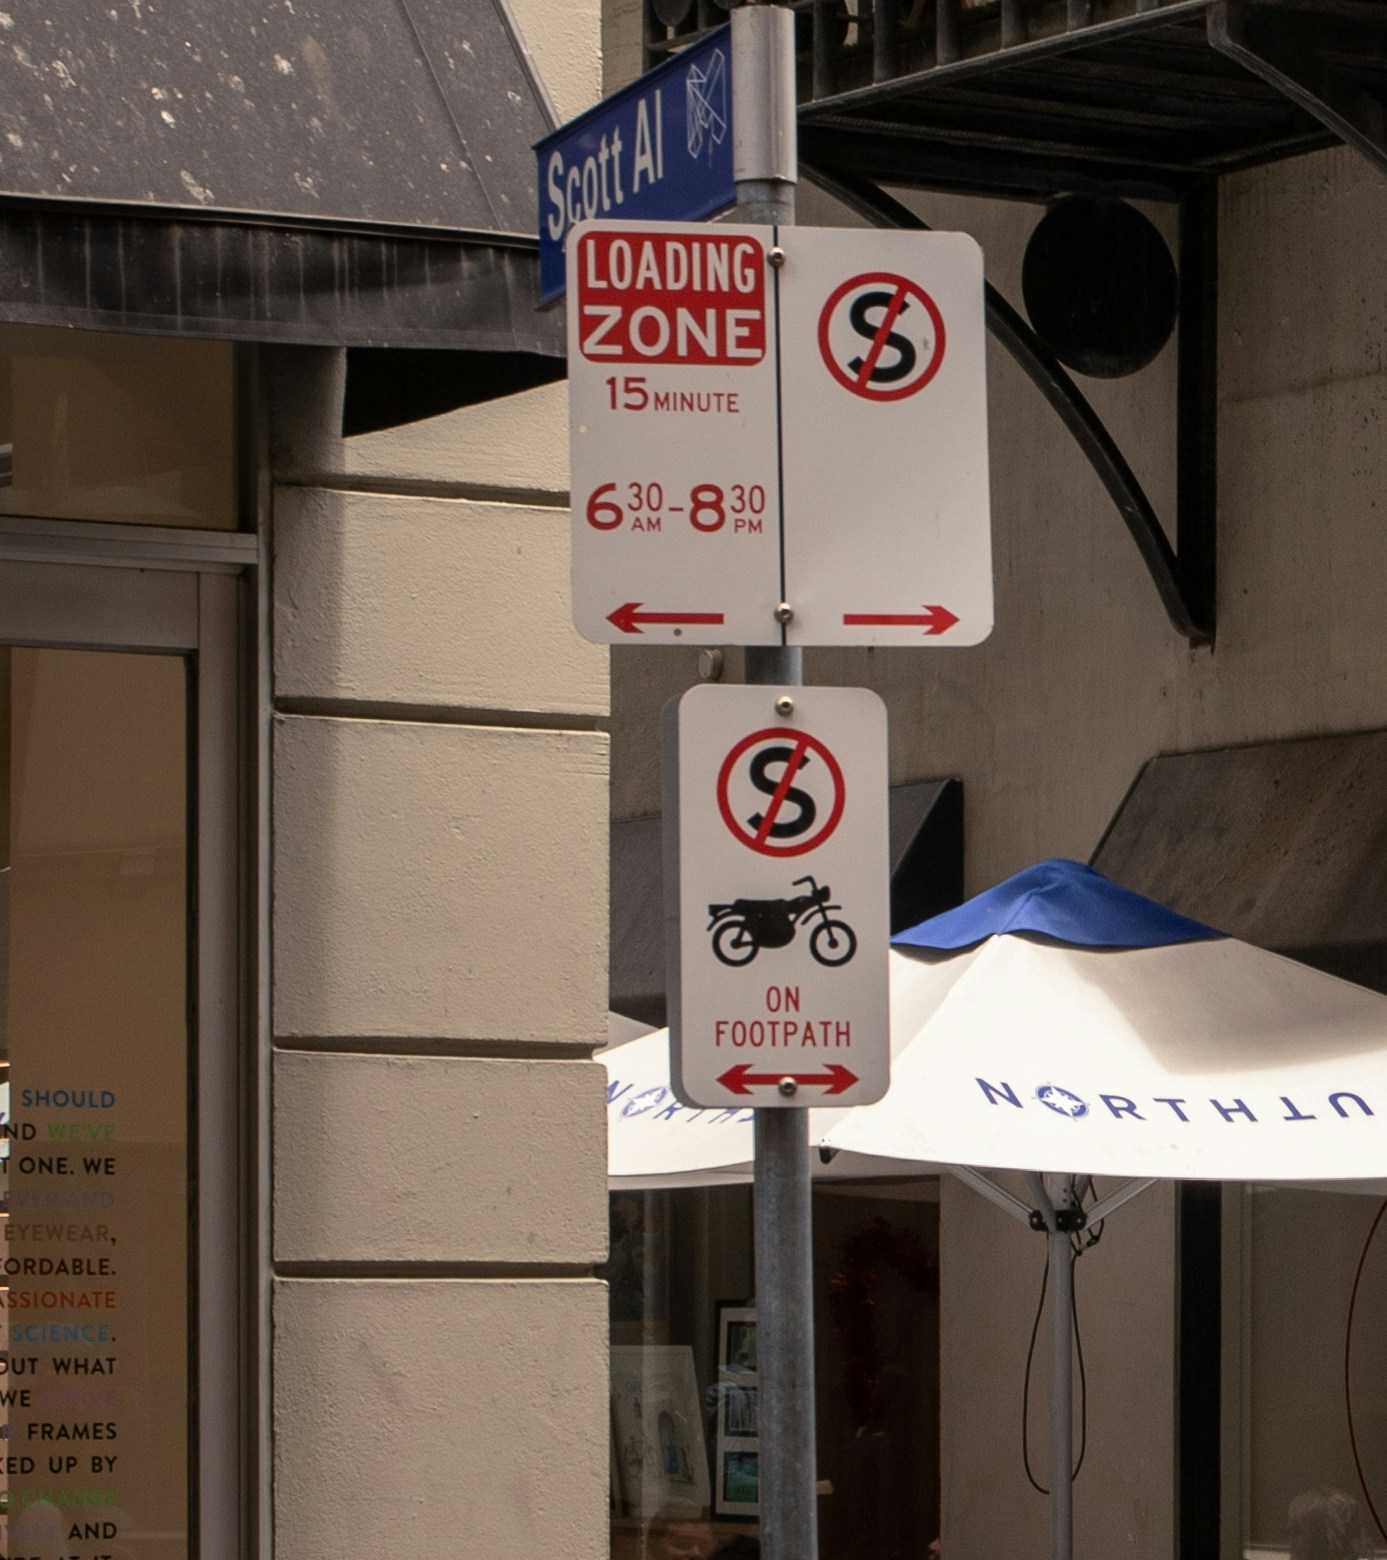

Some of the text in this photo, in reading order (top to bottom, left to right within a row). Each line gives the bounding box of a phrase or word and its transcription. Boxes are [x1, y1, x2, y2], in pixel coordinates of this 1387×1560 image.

[548, 88, 664, 241] Scott Al
[586, 239, 755, 293] LOADING
[583, 305, 762, 358] ZONE
[606, 377, 739, 412] 15 MINUTE
[765, 987, 801, 1013] ON
[715, 1020, 852, 1049] FOOTPATH
[21, 1088, 116, 1109] SHOULD
[19, 1156, 116, 1175] ONE. WE
[0, 1257, 116, 1276] ORDABLE.
[53, 1357, 117, 1375] WHAT
[27, 1423, 117, 1441] FRAMES
[48, 1456, 78, 1474] UP
[91, 1456, 117, 1473] BY
[68, 1522, 118, 1540] AND
